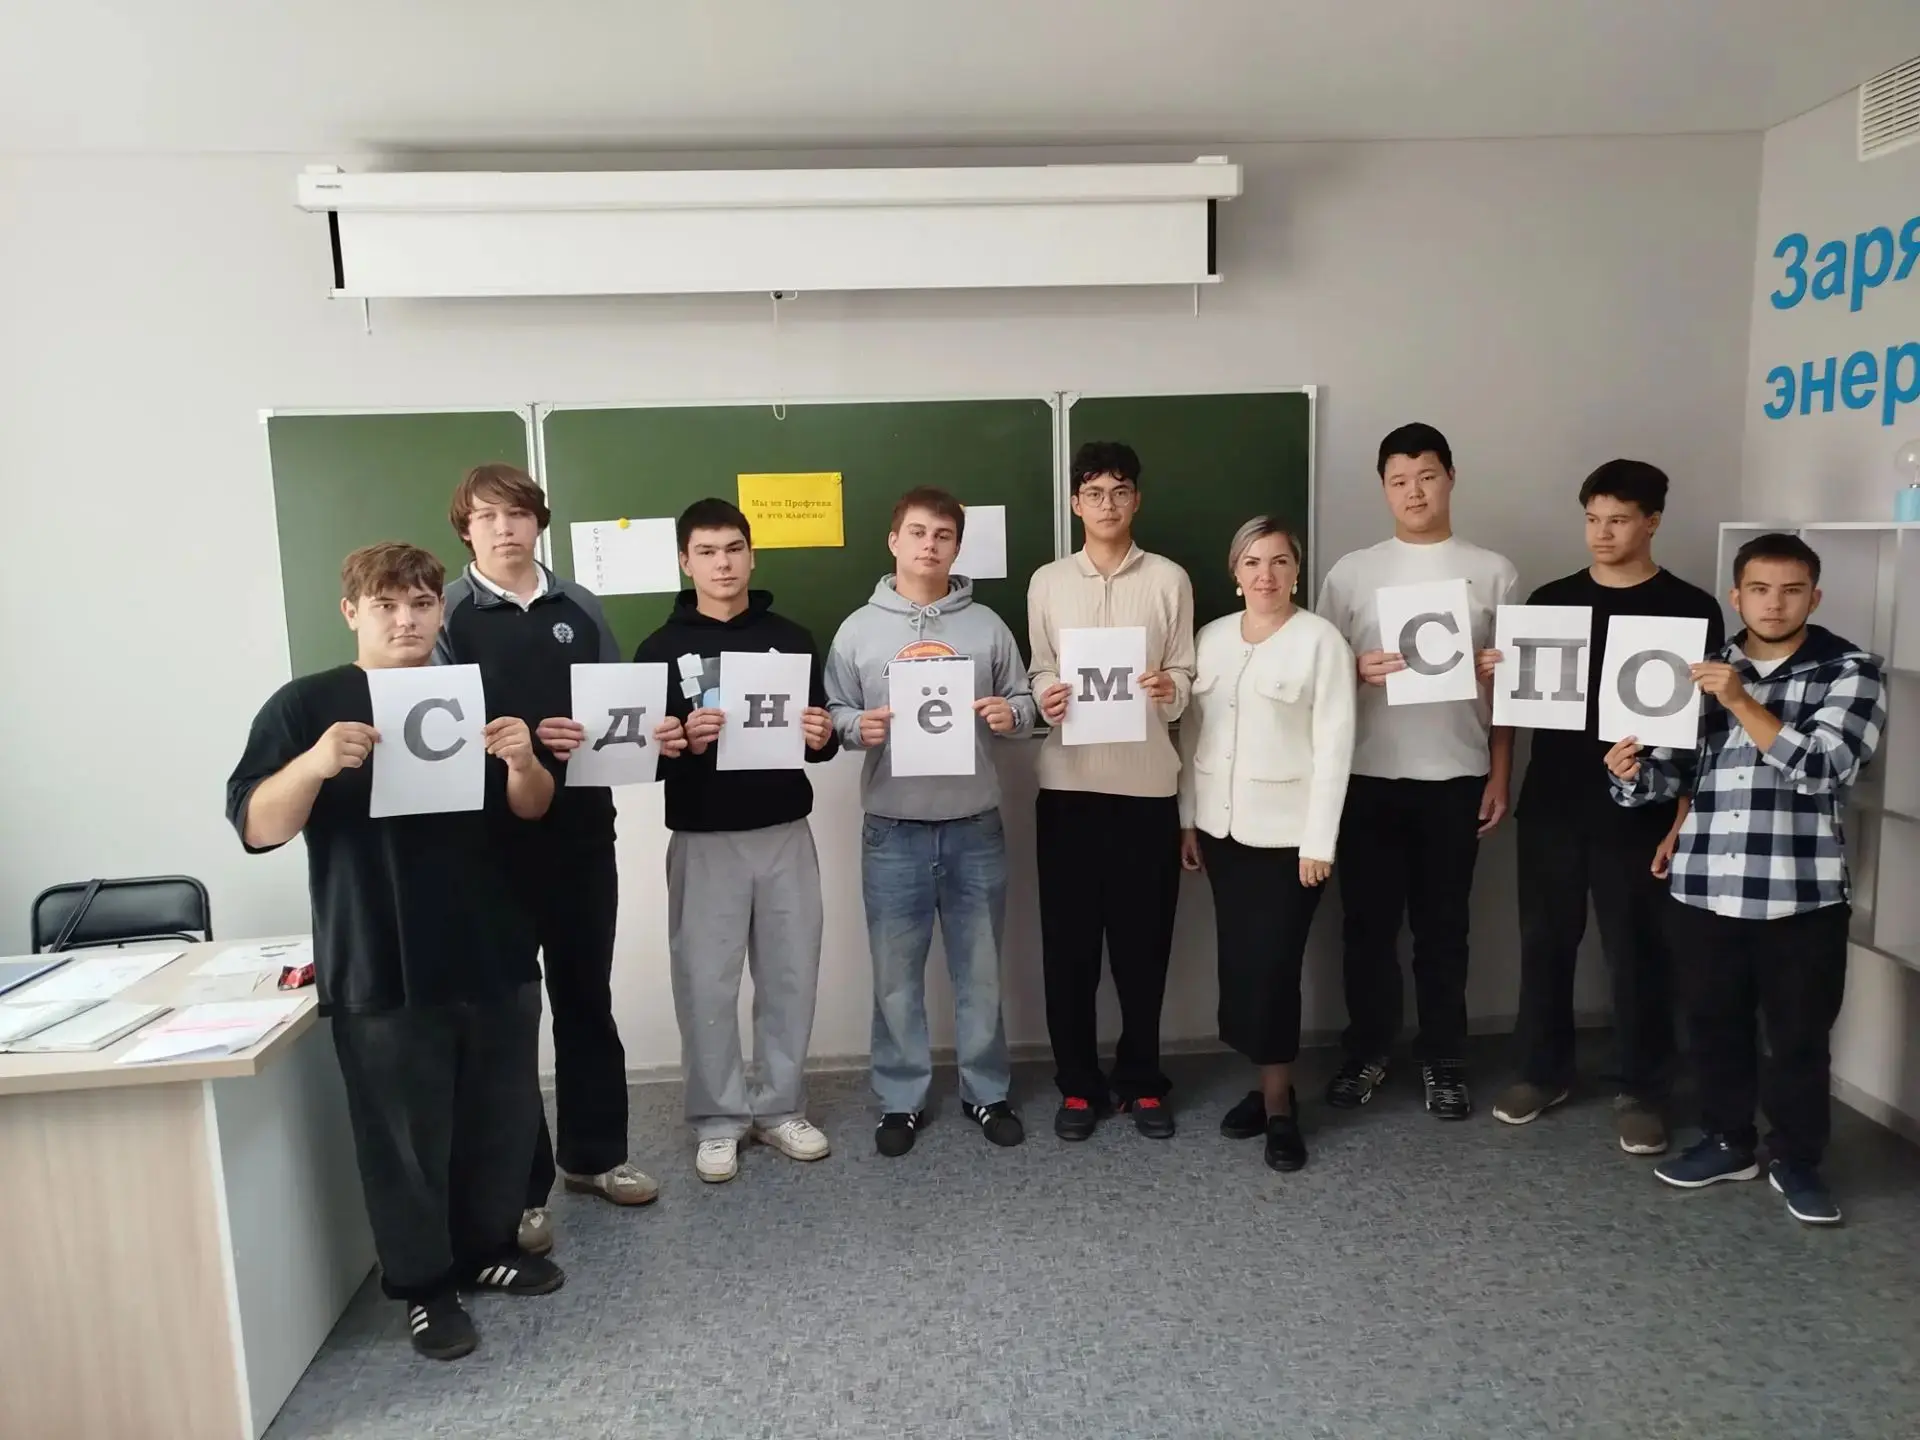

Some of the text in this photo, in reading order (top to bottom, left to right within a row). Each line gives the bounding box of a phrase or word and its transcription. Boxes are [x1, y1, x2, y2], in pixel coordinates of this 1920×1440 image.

[1763, 340, 1920, 426] энер
[752, 499, 768, 507] Мы
[1510, 638, 1588, 701] П
[917, 686, 953, 734] ё
